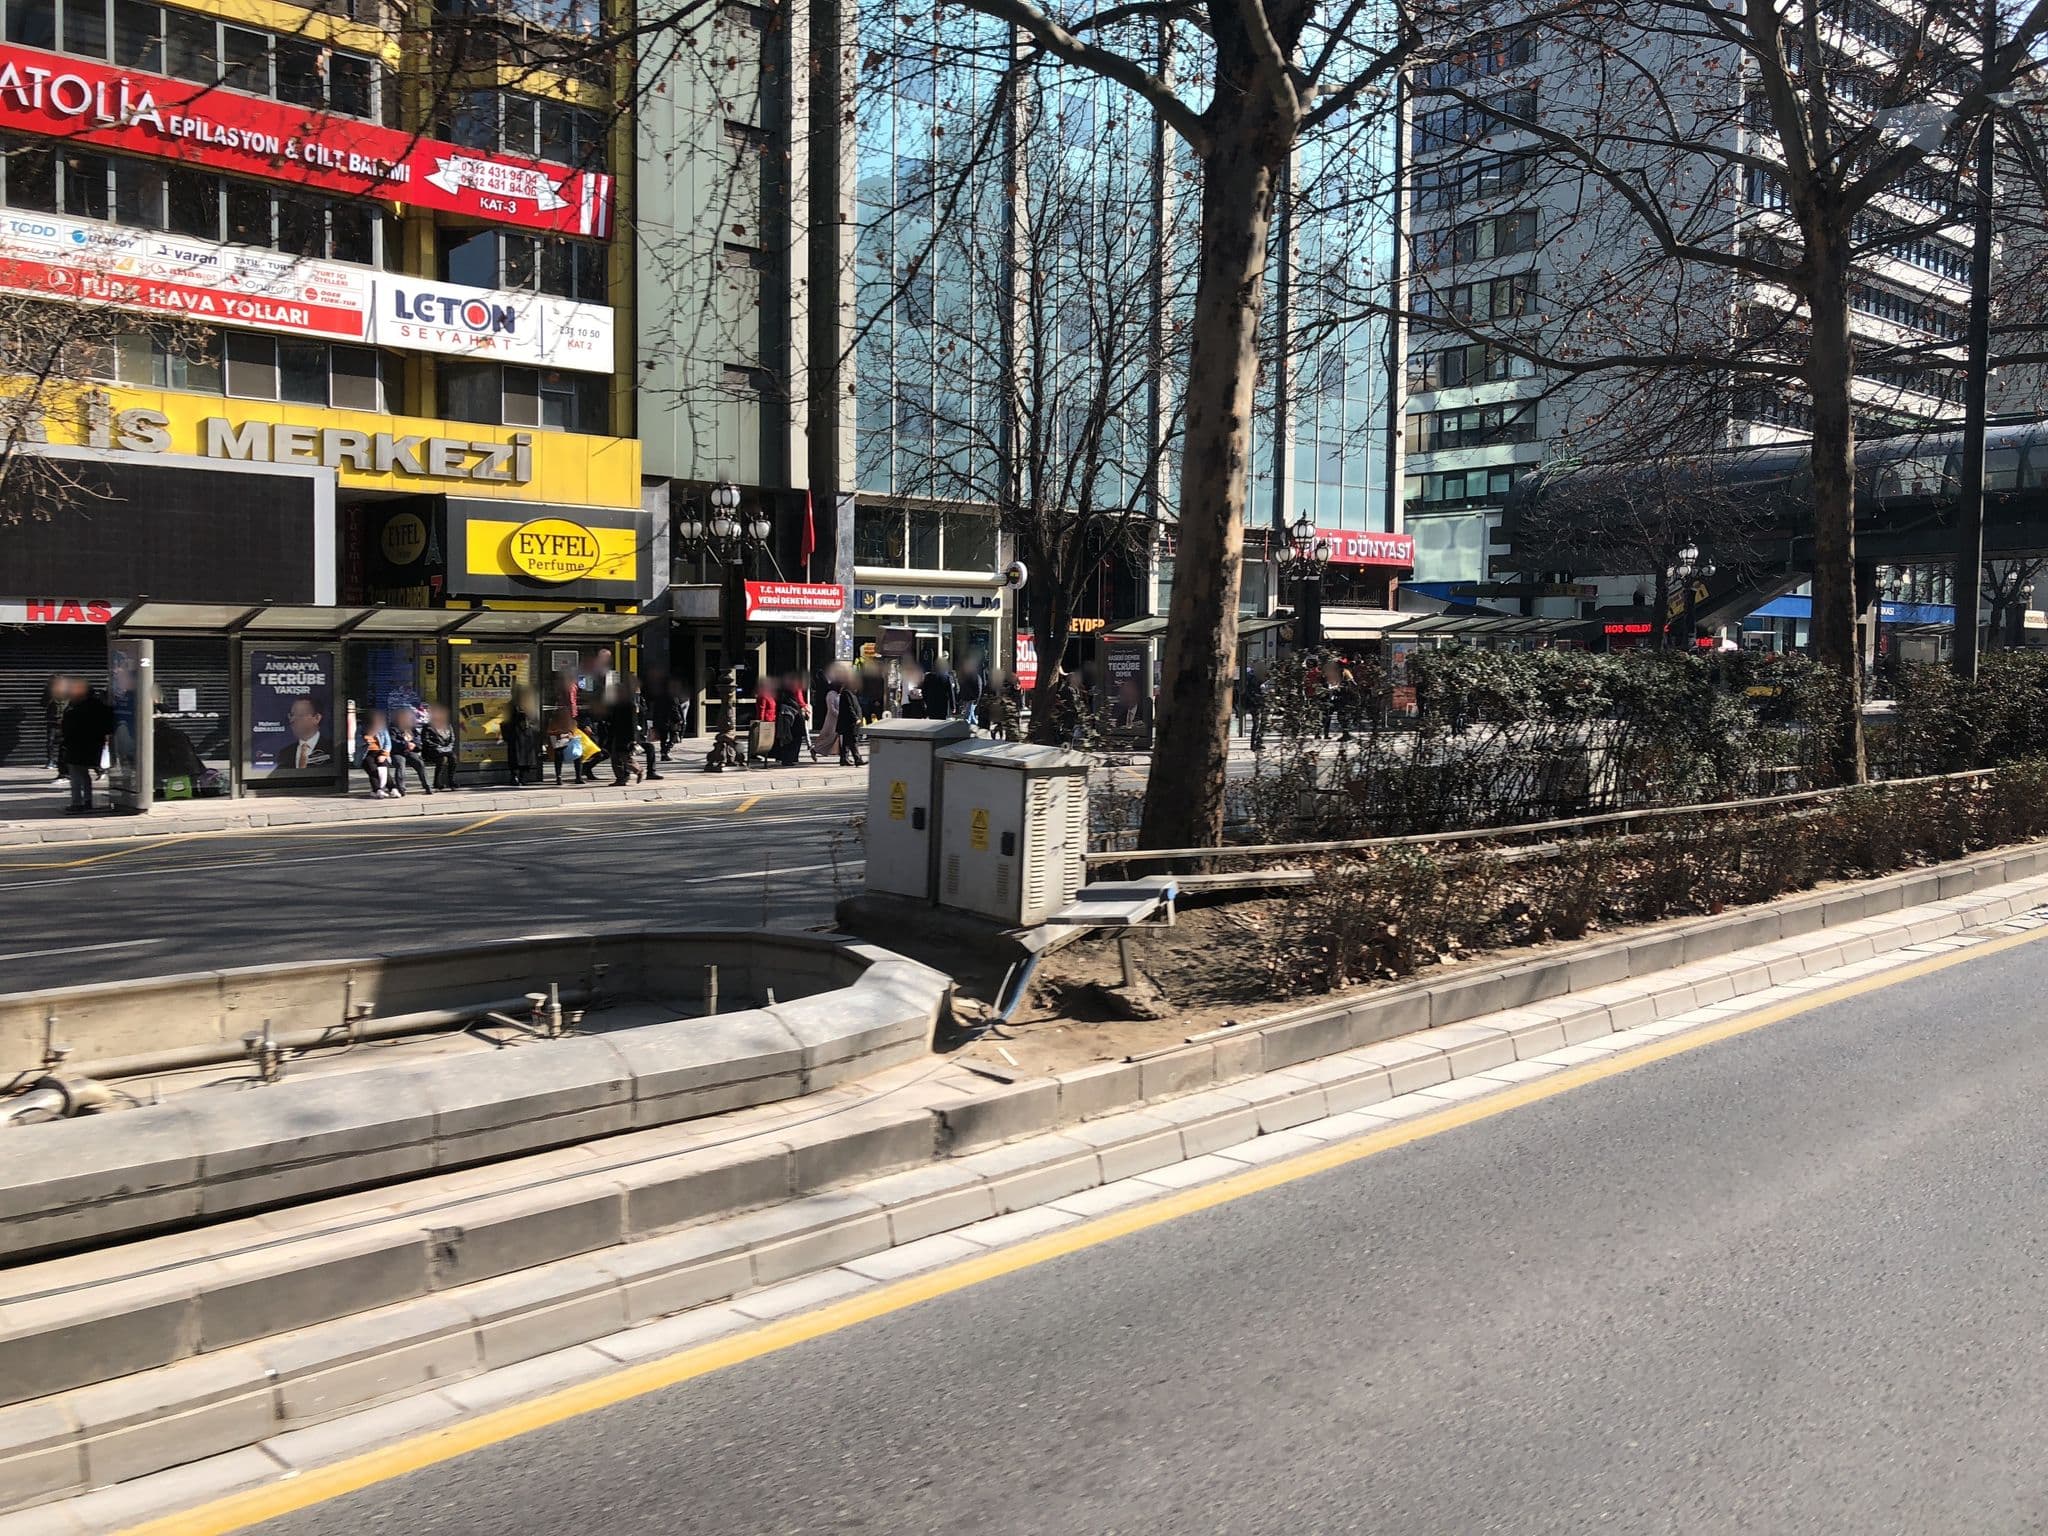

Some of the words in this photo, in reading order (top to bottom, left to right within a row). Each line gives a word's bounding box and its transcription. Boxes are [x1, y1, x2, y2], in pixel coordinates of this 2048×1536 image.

[169, 114, 279, 154] EPİLASYON
[285, 136, 299, 160] &
[303, 142, 346, 169] CİLT
[349, 153, 410, 183] BAMI
[461, 162, 467, 171] 0
[488, 167, 506, 179] 431
[510, 170, 524, 182] 94
[488, 179, 506, 191] 431
[510, 182, 524, 193] 94
[480, 197, 517, 214] KAT-3
[9, 221, 57, 237] TCDD
[174, 250, 218, 265] varan
[81, 274, 141, 299] TÜRK
[149, 286, 215, 313] HAVA
[221, 298, 309, 326] YOLLARI
[395, 289, 516, 334] LETON
[400, 325, 512, 350] SEYAHAT
[589, 329, 600, 339] 50
[567, 339, 585, 350] KAT
[587, 341, 593, 350] 2
[203, 416, 533, 483] MERKEZİ
[519, 533, 594, 558] EYFEL
[1347, 534, 1412, 559] DÜNYASI
[528, 558, 586, 572] Perfume
[760, 585, 774, 593] T.C.
[775, 585, 801, 595] MALİYE
[802, 586, 840, 596] BAKANLIĞI
[758, 595, 780, 604] VERGİ
[781, 596, 813, 605] DENETİM
[813, 597, 841, 606] KURULU
[879, 594, 1001, 610] FENERIUM
[26, 599, 112, 623] HAS
[140, 657, 151, 667] 2
[258, 671, 326, 685] TECRÜBE
